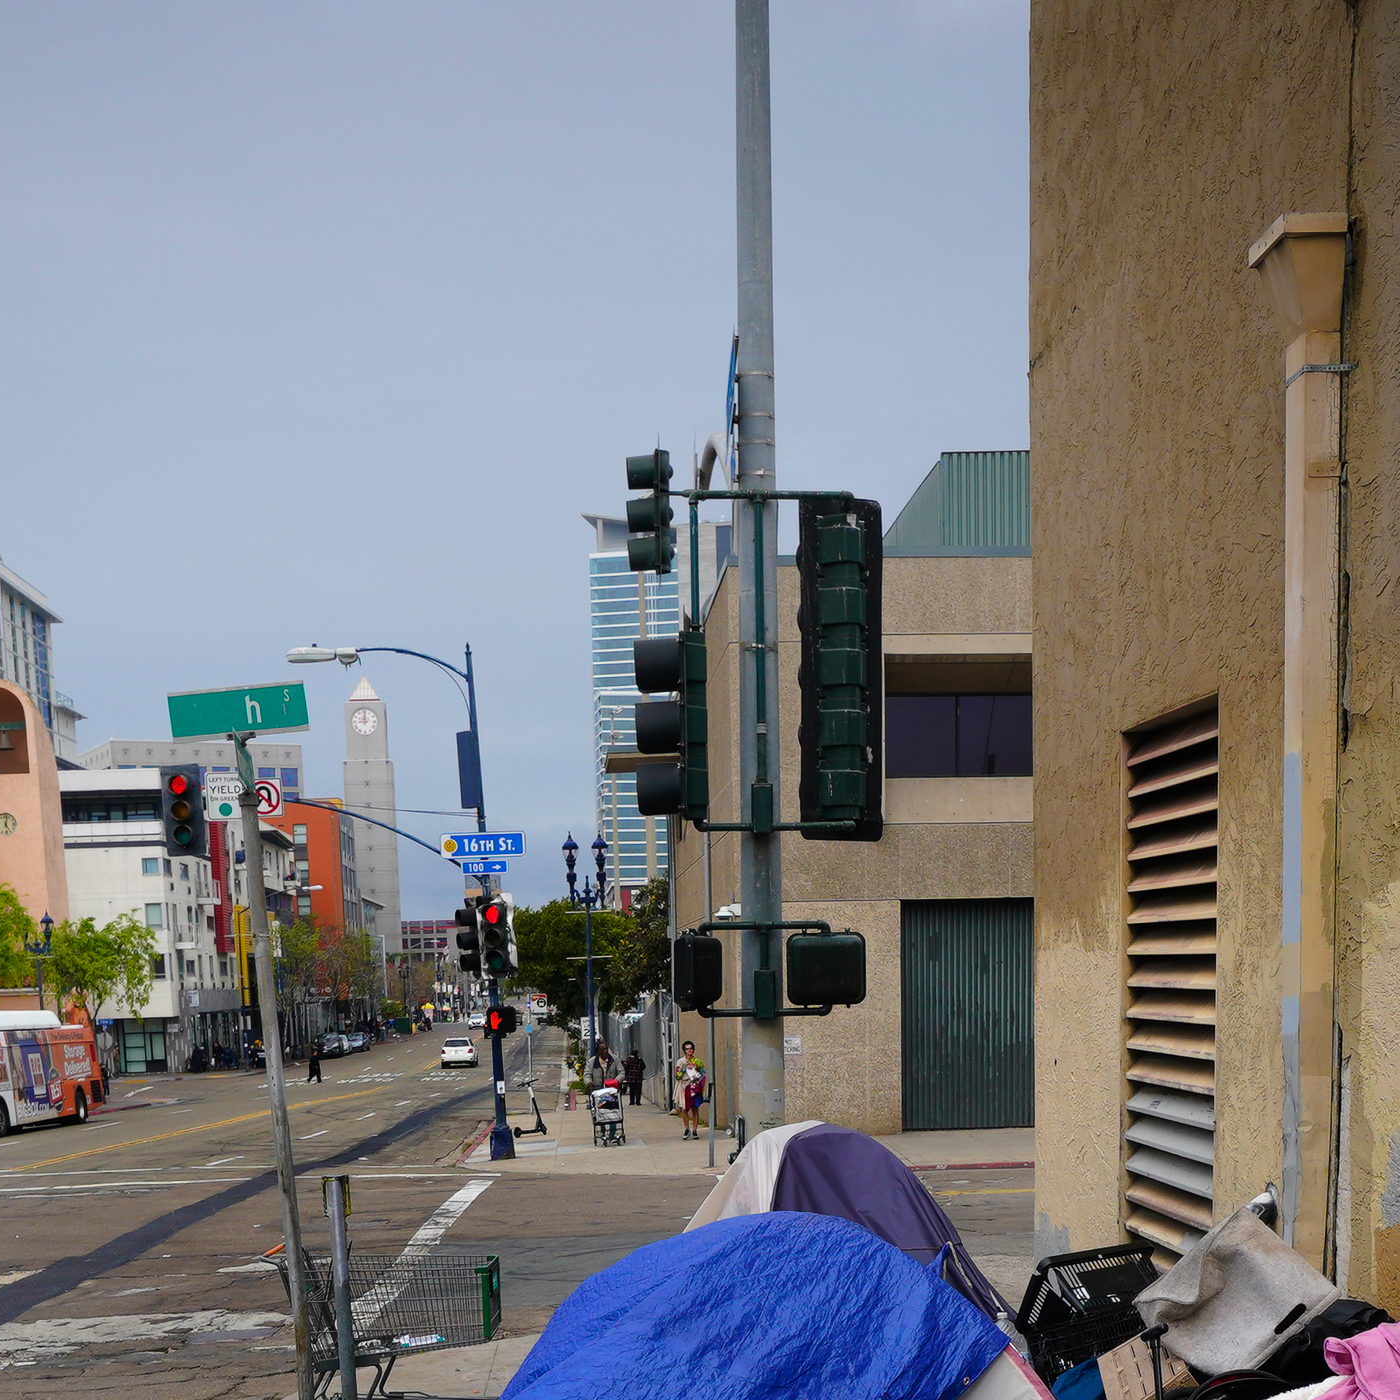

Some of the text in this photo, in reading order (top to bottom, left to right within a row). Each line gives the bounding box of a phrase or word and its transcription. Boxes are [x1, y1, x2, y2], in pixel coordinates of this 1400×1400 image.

[209, 785, 241, 794] YIELD
[463, 838, 494, 852] 16TH
[468, 863, 484, 872] 100
[64, 1045, 85, 1059] Storage
